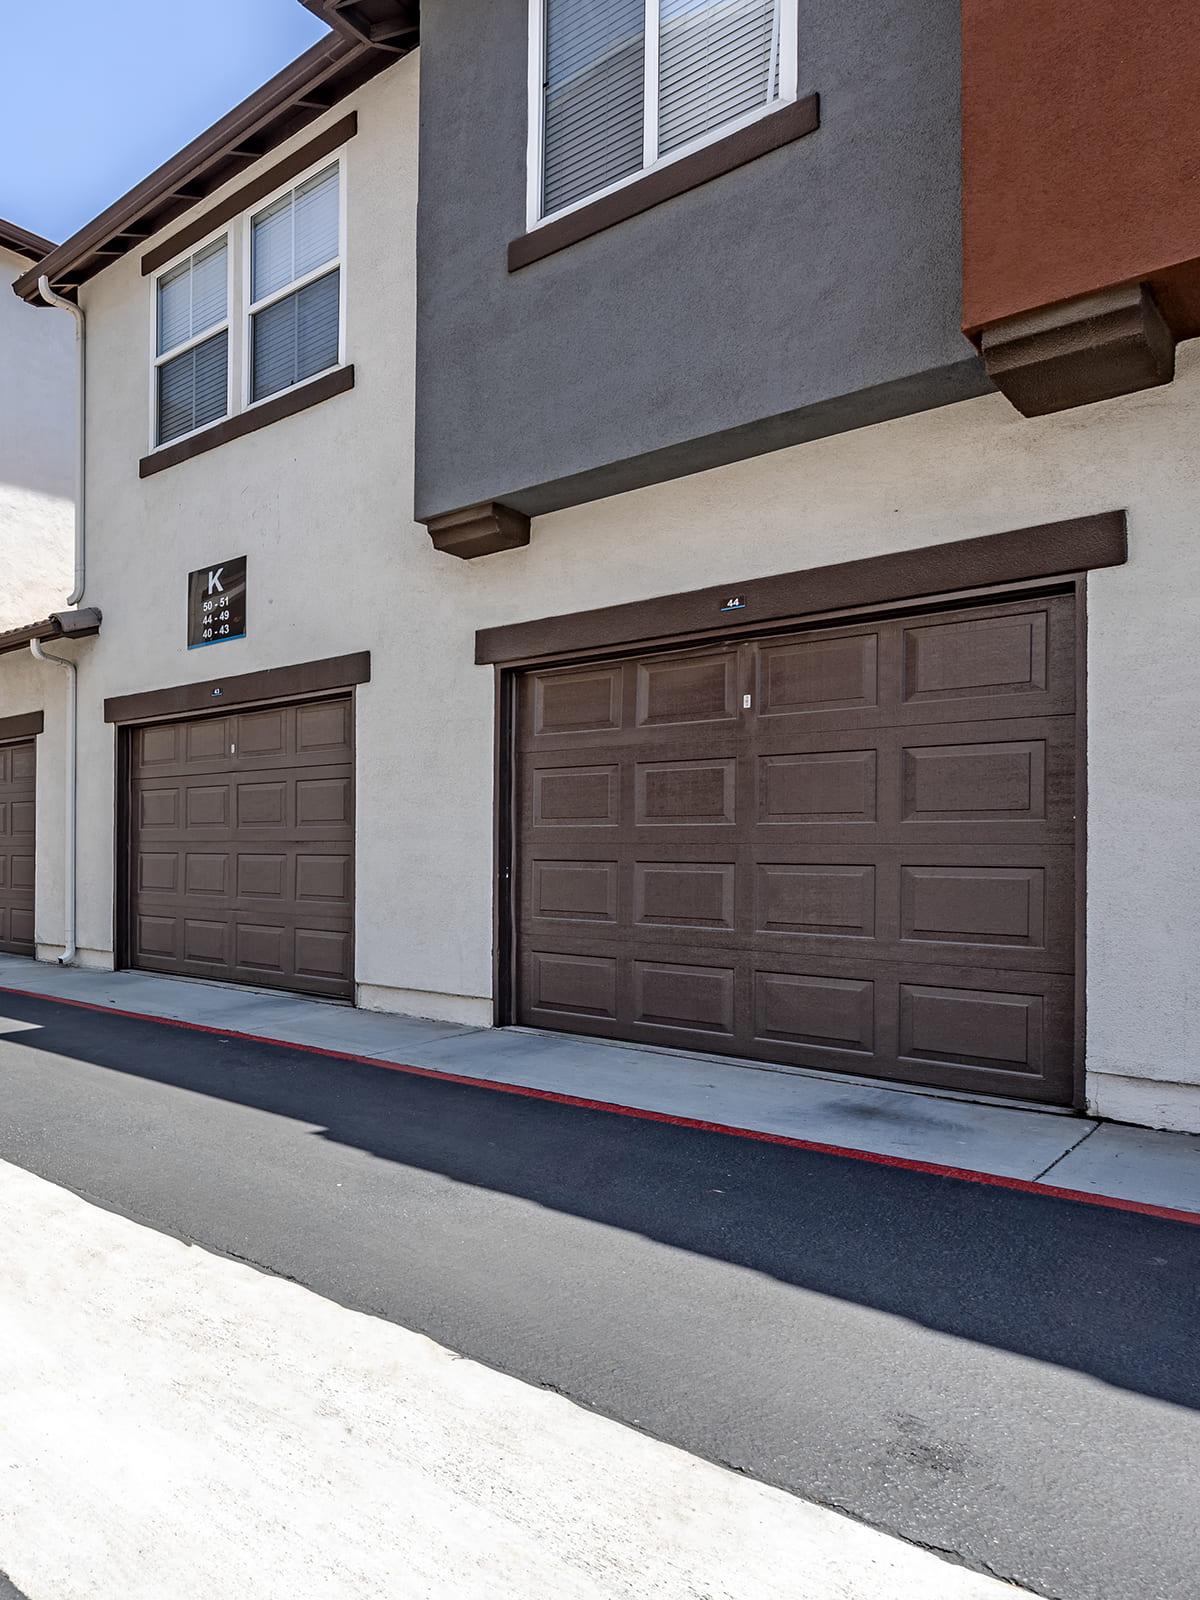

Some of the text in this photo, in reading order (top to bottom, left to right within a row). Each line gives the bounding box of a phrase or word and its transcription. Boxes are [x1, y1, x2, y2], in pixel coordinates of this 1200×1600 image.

[208, 567, 224, 595] K
[203, 601, 213, 612] 50
[220, 596, 229, 608] 51
[202, 614, 213, 625] 44
[219, 610, 230, 621] 49
[202, 628, 213, 639] 40
[219, 624, 230, 635] 43
